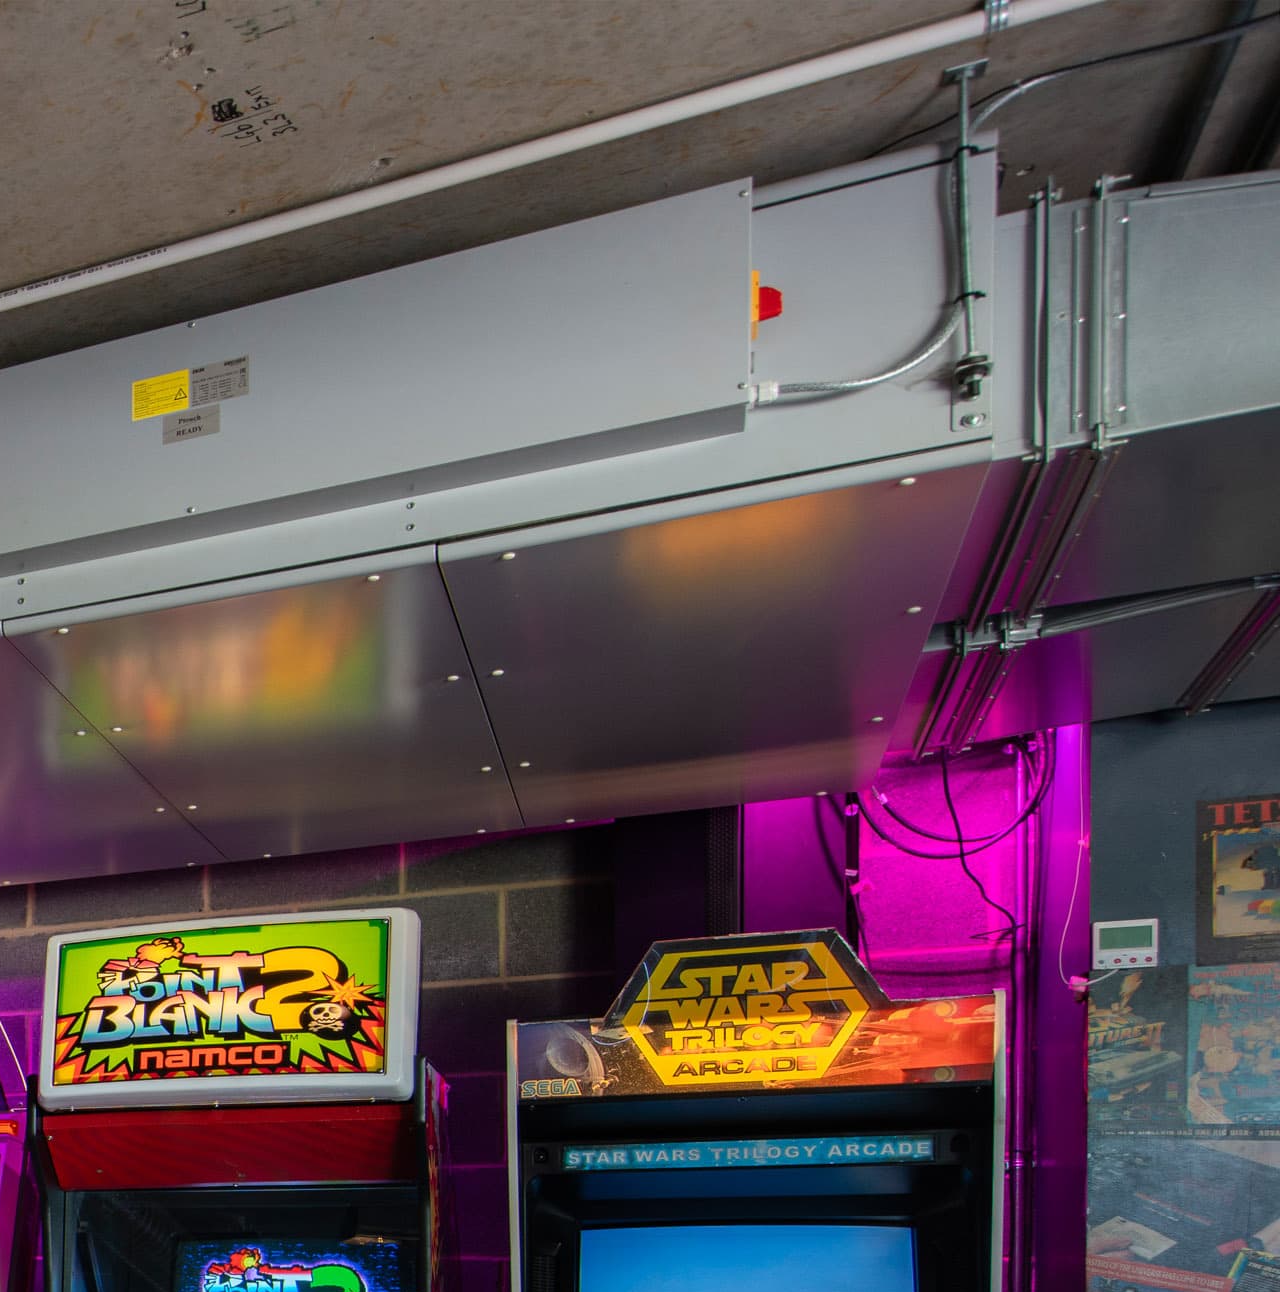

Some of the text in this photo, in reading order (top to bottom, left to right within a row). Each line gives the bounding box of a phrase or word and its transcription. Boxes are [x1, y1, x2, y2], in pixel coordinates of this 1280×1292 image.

[1207, 799, 1280, 826] TET
[98, 951, 266, 1001] POINT
[660, 961, 826, 999] STAR
[80, 946, 348, 1045] BLANK 2
[645, 992, 826, 1028] WARS
[665, 1023, 822, 1051] TRILOGY
[139, 1046, 284, 1070] namco
[672, 1055, 817, 1078] ARCADE
[521, 1078, 583, 1098] SEGA
[568, 1141, 932, 1165] STAR WARS TRILOGY ARCADE
